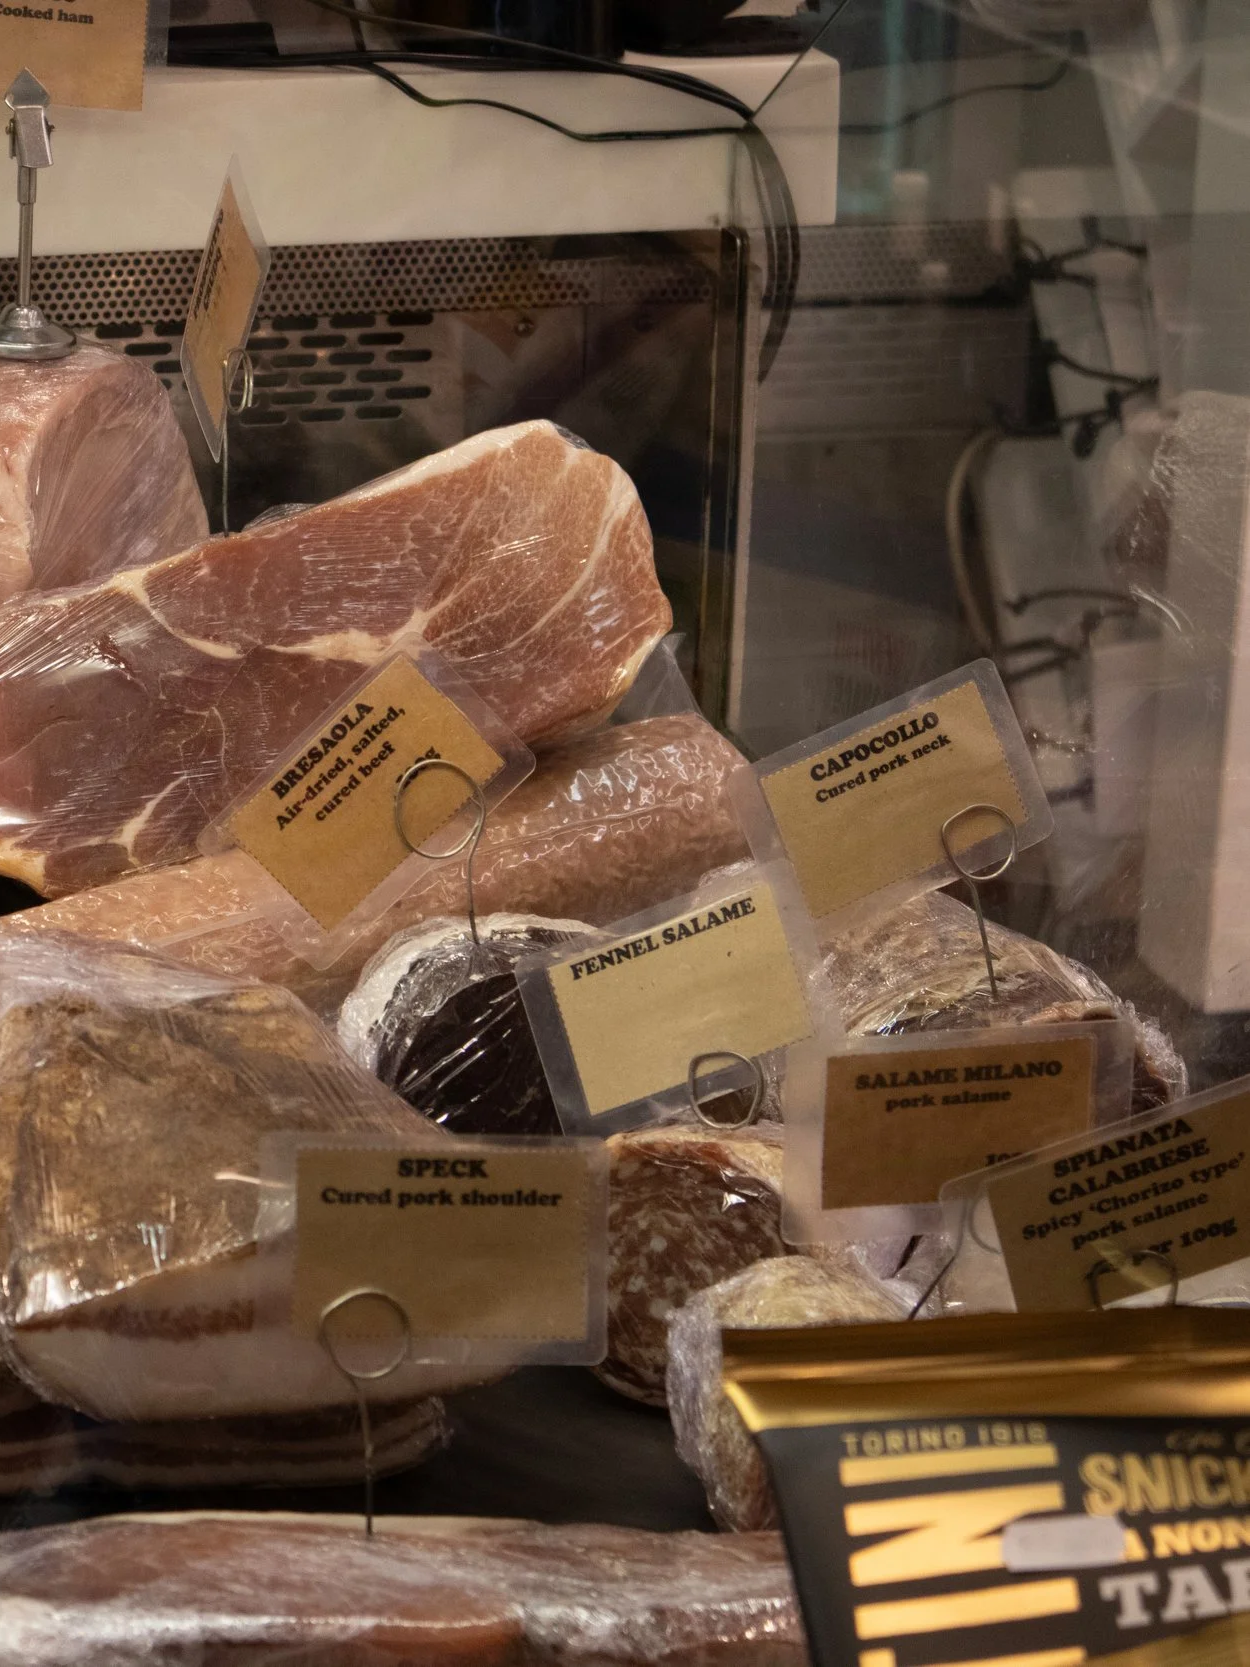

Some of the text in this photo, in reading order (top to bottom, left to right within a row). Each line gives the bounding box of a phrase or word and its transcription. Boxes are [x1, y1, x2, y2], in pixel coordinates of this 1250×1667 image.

[57, 8, 94, 25] ham
[271, 702, 374, 800] BRESAOLA
[276, 705, 405, 831] Air-dried, salted,
[810, 711, 939, 781] CAPOCOLLO
[815, 733, 952, 803] Cured pork neck
[315, 740, 397, 822] cured beef
[570, 897, 756, 981] FENNEL SALAME
[855, 1060, 1063, 1090] SALAME MILANO
[885, 1090, 1012, 1113] pork salame
[398, 1158, 489, 1179] SPECK
[1048, 1138, 1211, 1206] CALABRESE
[1053, 1118, 1194, 1178] SPIANATA
[321, 1187, 562, 1208] Cured pork shoulder
[1022, 1209, 1083, 1241] Spicy
[1071, 1192, 1209, 1250] pork salame
[1180, 1217, 1238, 1248] 100g
[841, 1422, 966, 1457] TORINO
